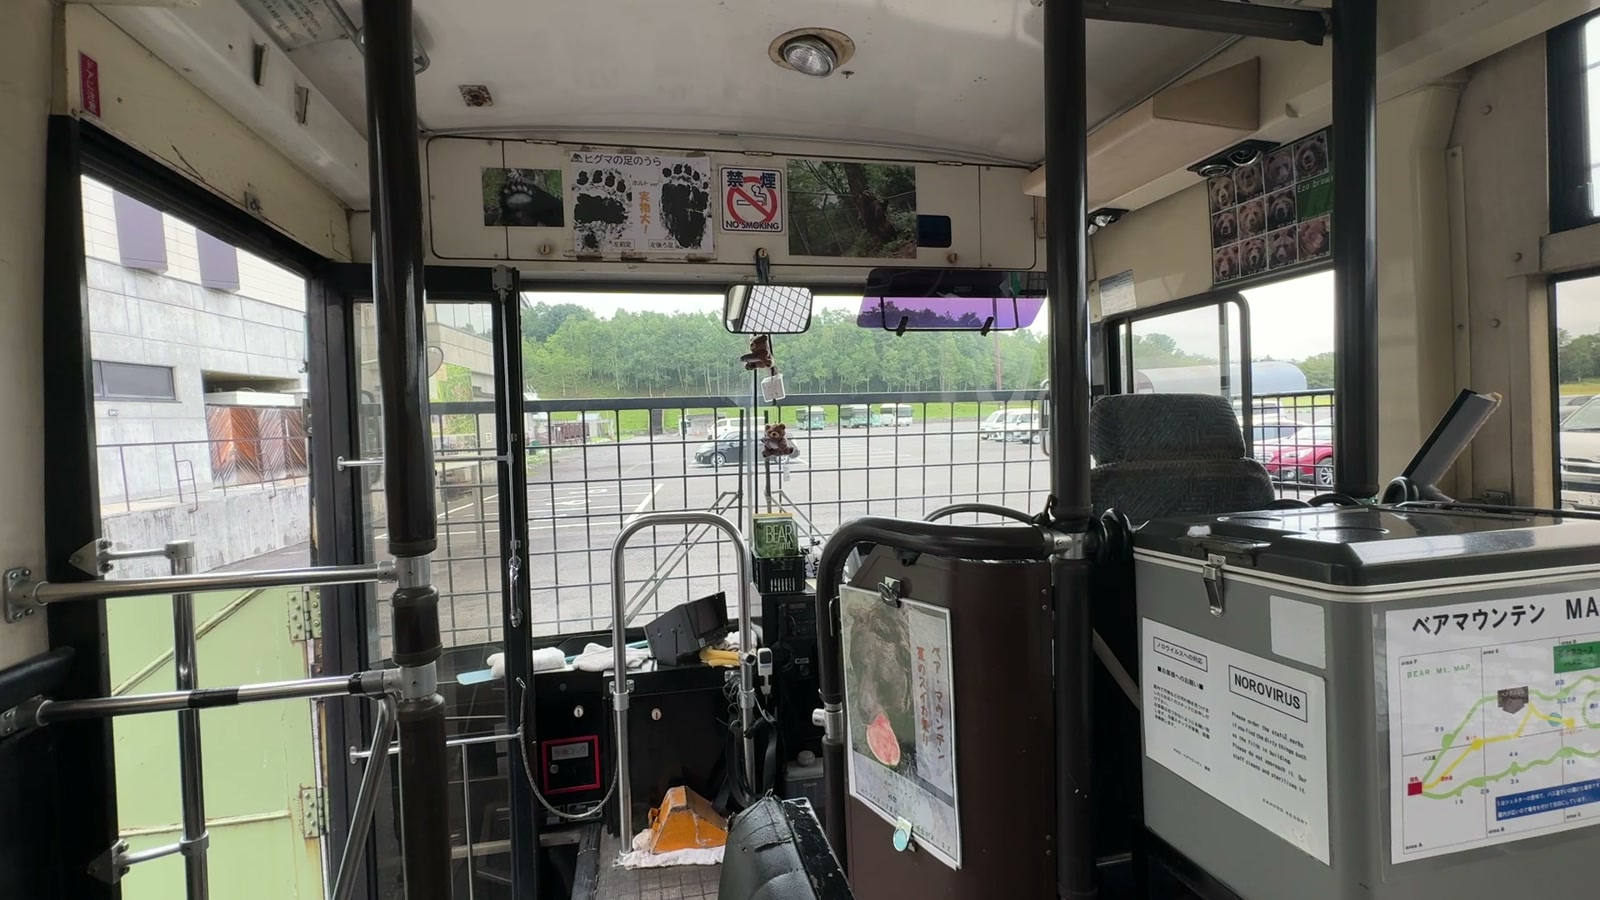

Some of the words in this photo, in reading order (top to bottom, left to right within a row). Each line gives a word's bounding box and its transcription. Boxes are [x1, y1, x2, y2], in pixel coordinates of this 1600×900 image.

[584, 154, 661, 167] ヒグマの足のうら
[725, 220, 740, 229] NO
[741, 221, 780, 230] SMOKING
[613, 240, 632, 249] 左前足
[650, 240, 674, 250] 左後ろ足
[765, 524, 793, 544] BEAR
[1412, 603, 1545, 636] ベアマウンテン
[1406, 669, 1430, 679] BEAR
[1453, 663, 1471, 672] MAP
[1234, 672, 1301, 710] NOROVIRUS
